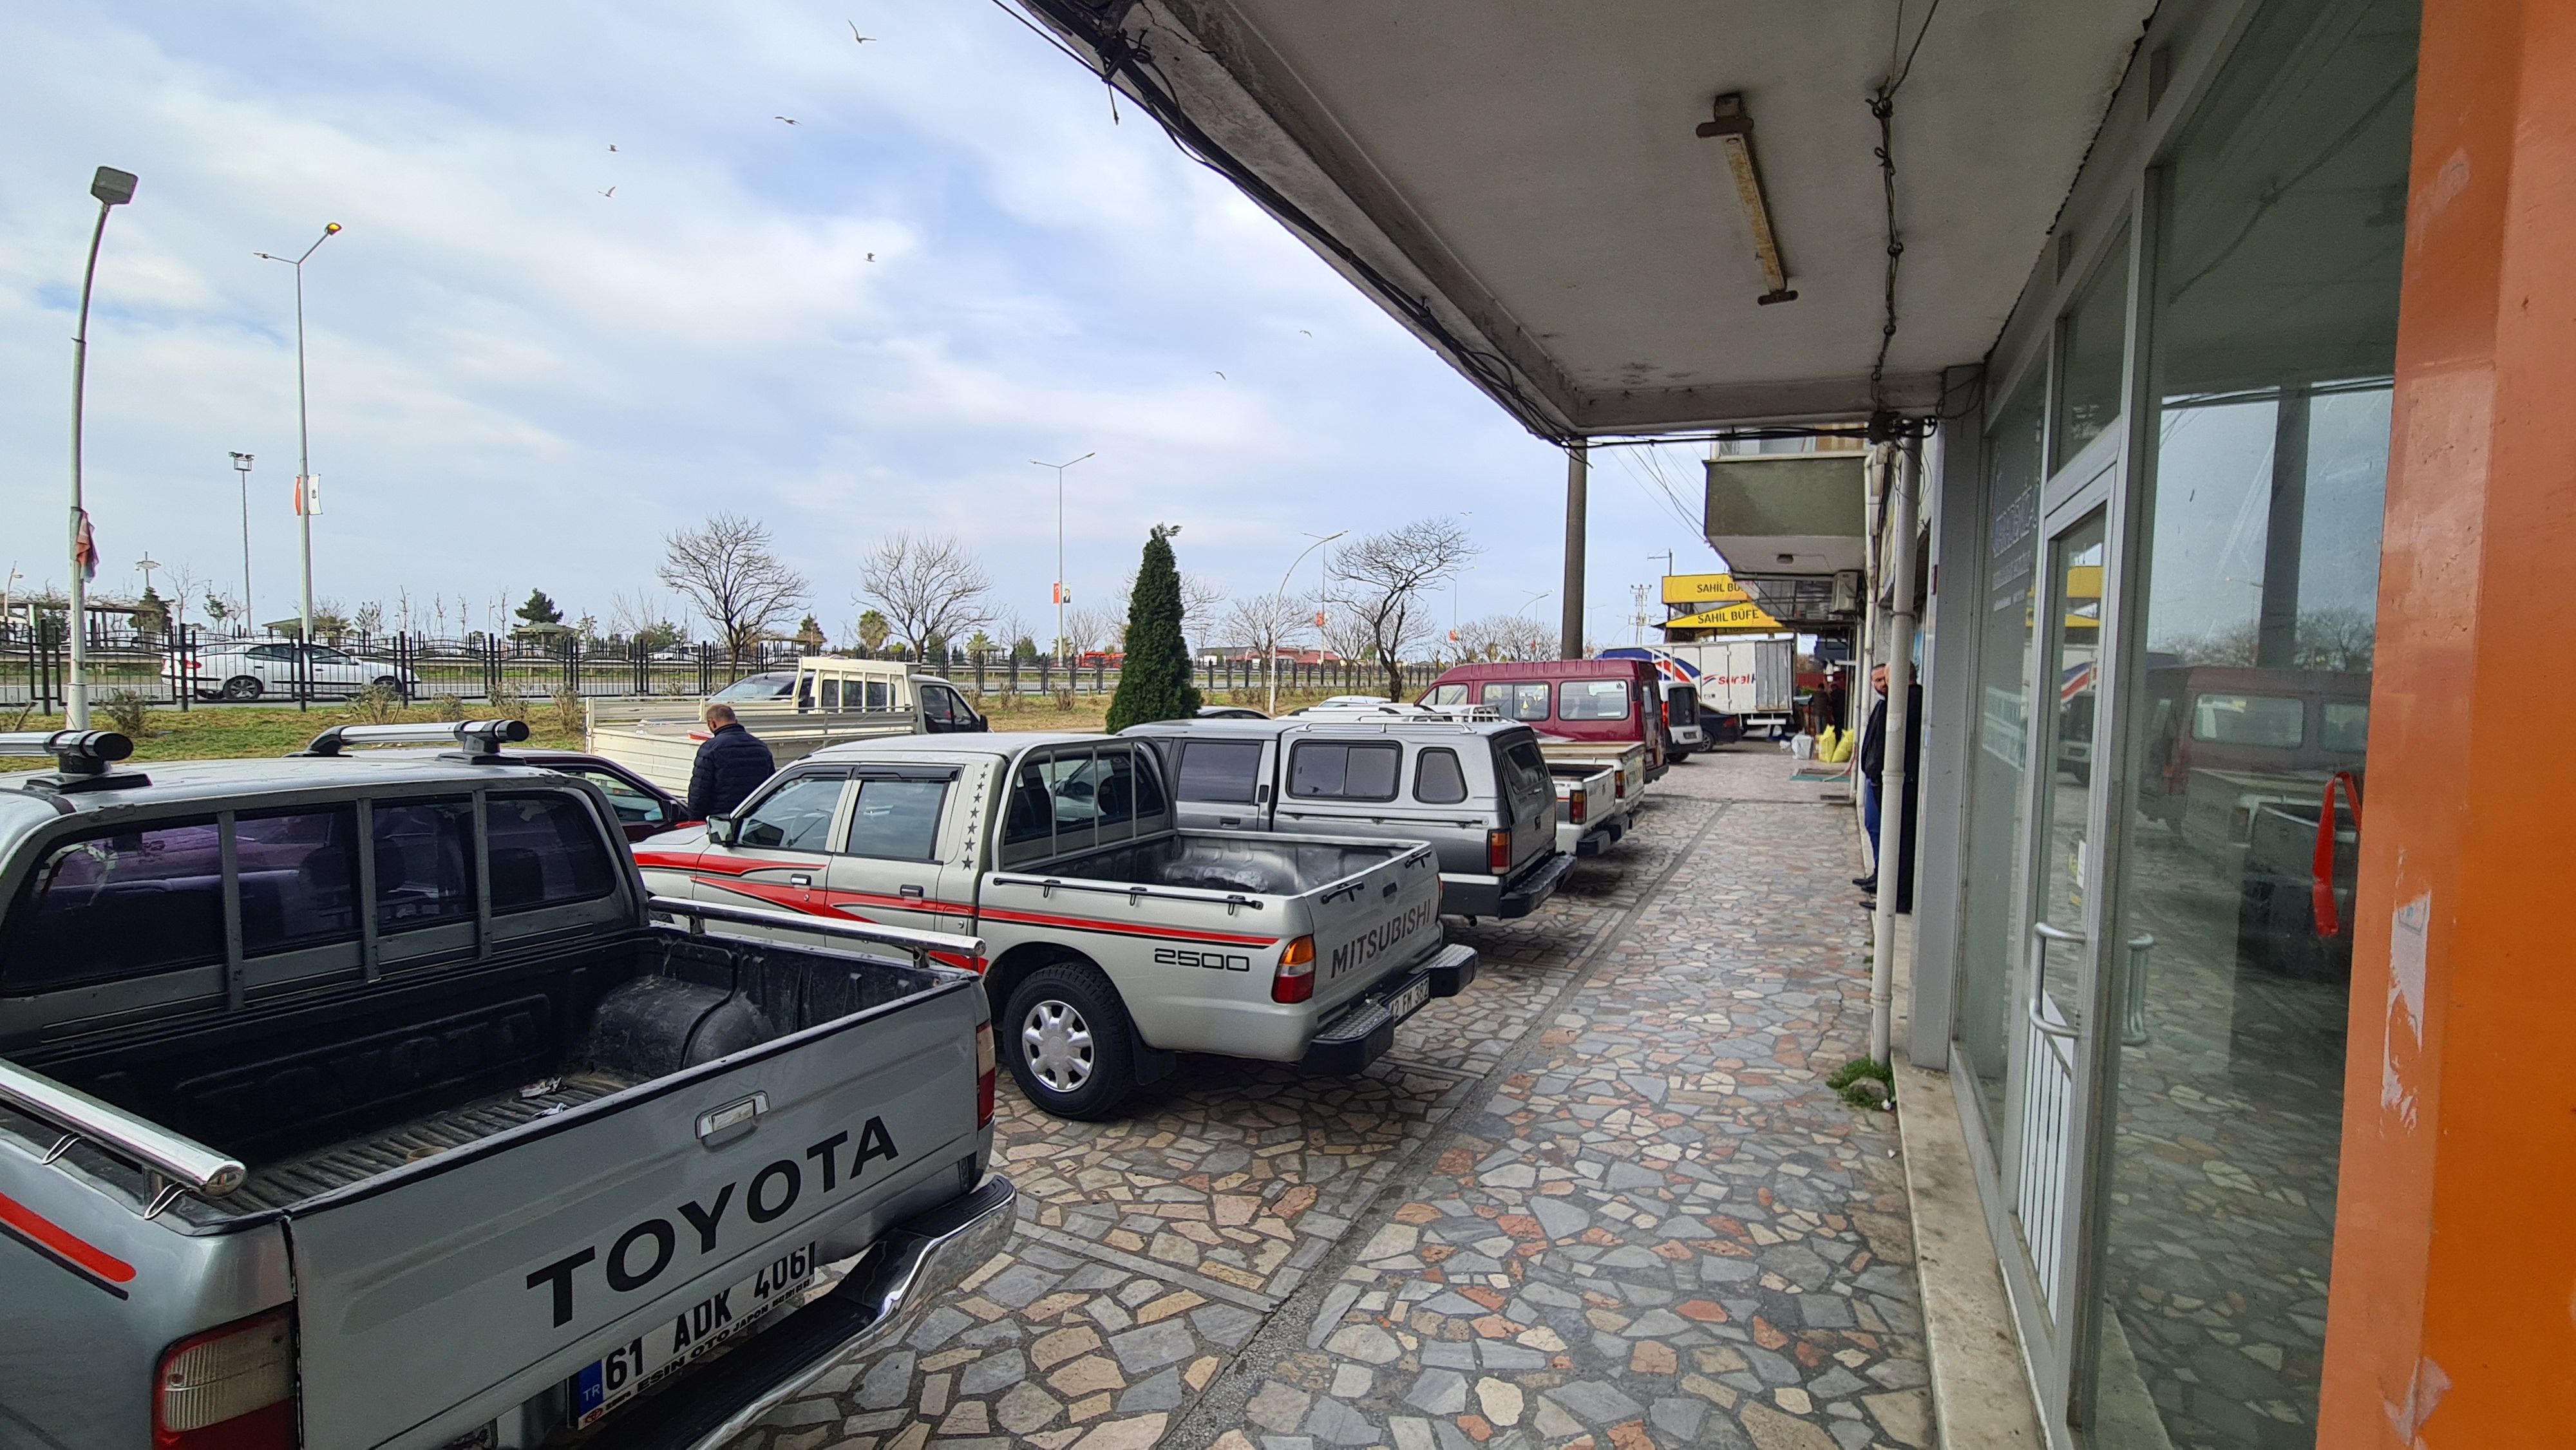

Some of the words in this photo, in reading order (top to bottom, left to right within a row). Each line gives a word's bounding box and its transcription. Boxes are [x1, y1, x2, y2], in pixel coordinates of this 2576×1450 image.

[1697, 582, 1725, 593] SAHİL
[1698, 610, 1728, 624] SAHİL
[1731, 608, 1759, 620] BÜFE
[1331, 899, 1430, 979] MITSUBISHI
[1155, 948, 1249, 972] 2500
[1415, 979, 1428, 1004] 382
[527, 1116, 898, 1328] TOYOTA
[606, 1337, 643, 1390] 61
[674, 1288, 733, 1354] ADK
[754, 1247, 806, 1299] 406
[690, 1329, 730, 1358] OTO
[733, 1304, 768, 1332] JAPON
[583, 1384, 600, 1401] TR
